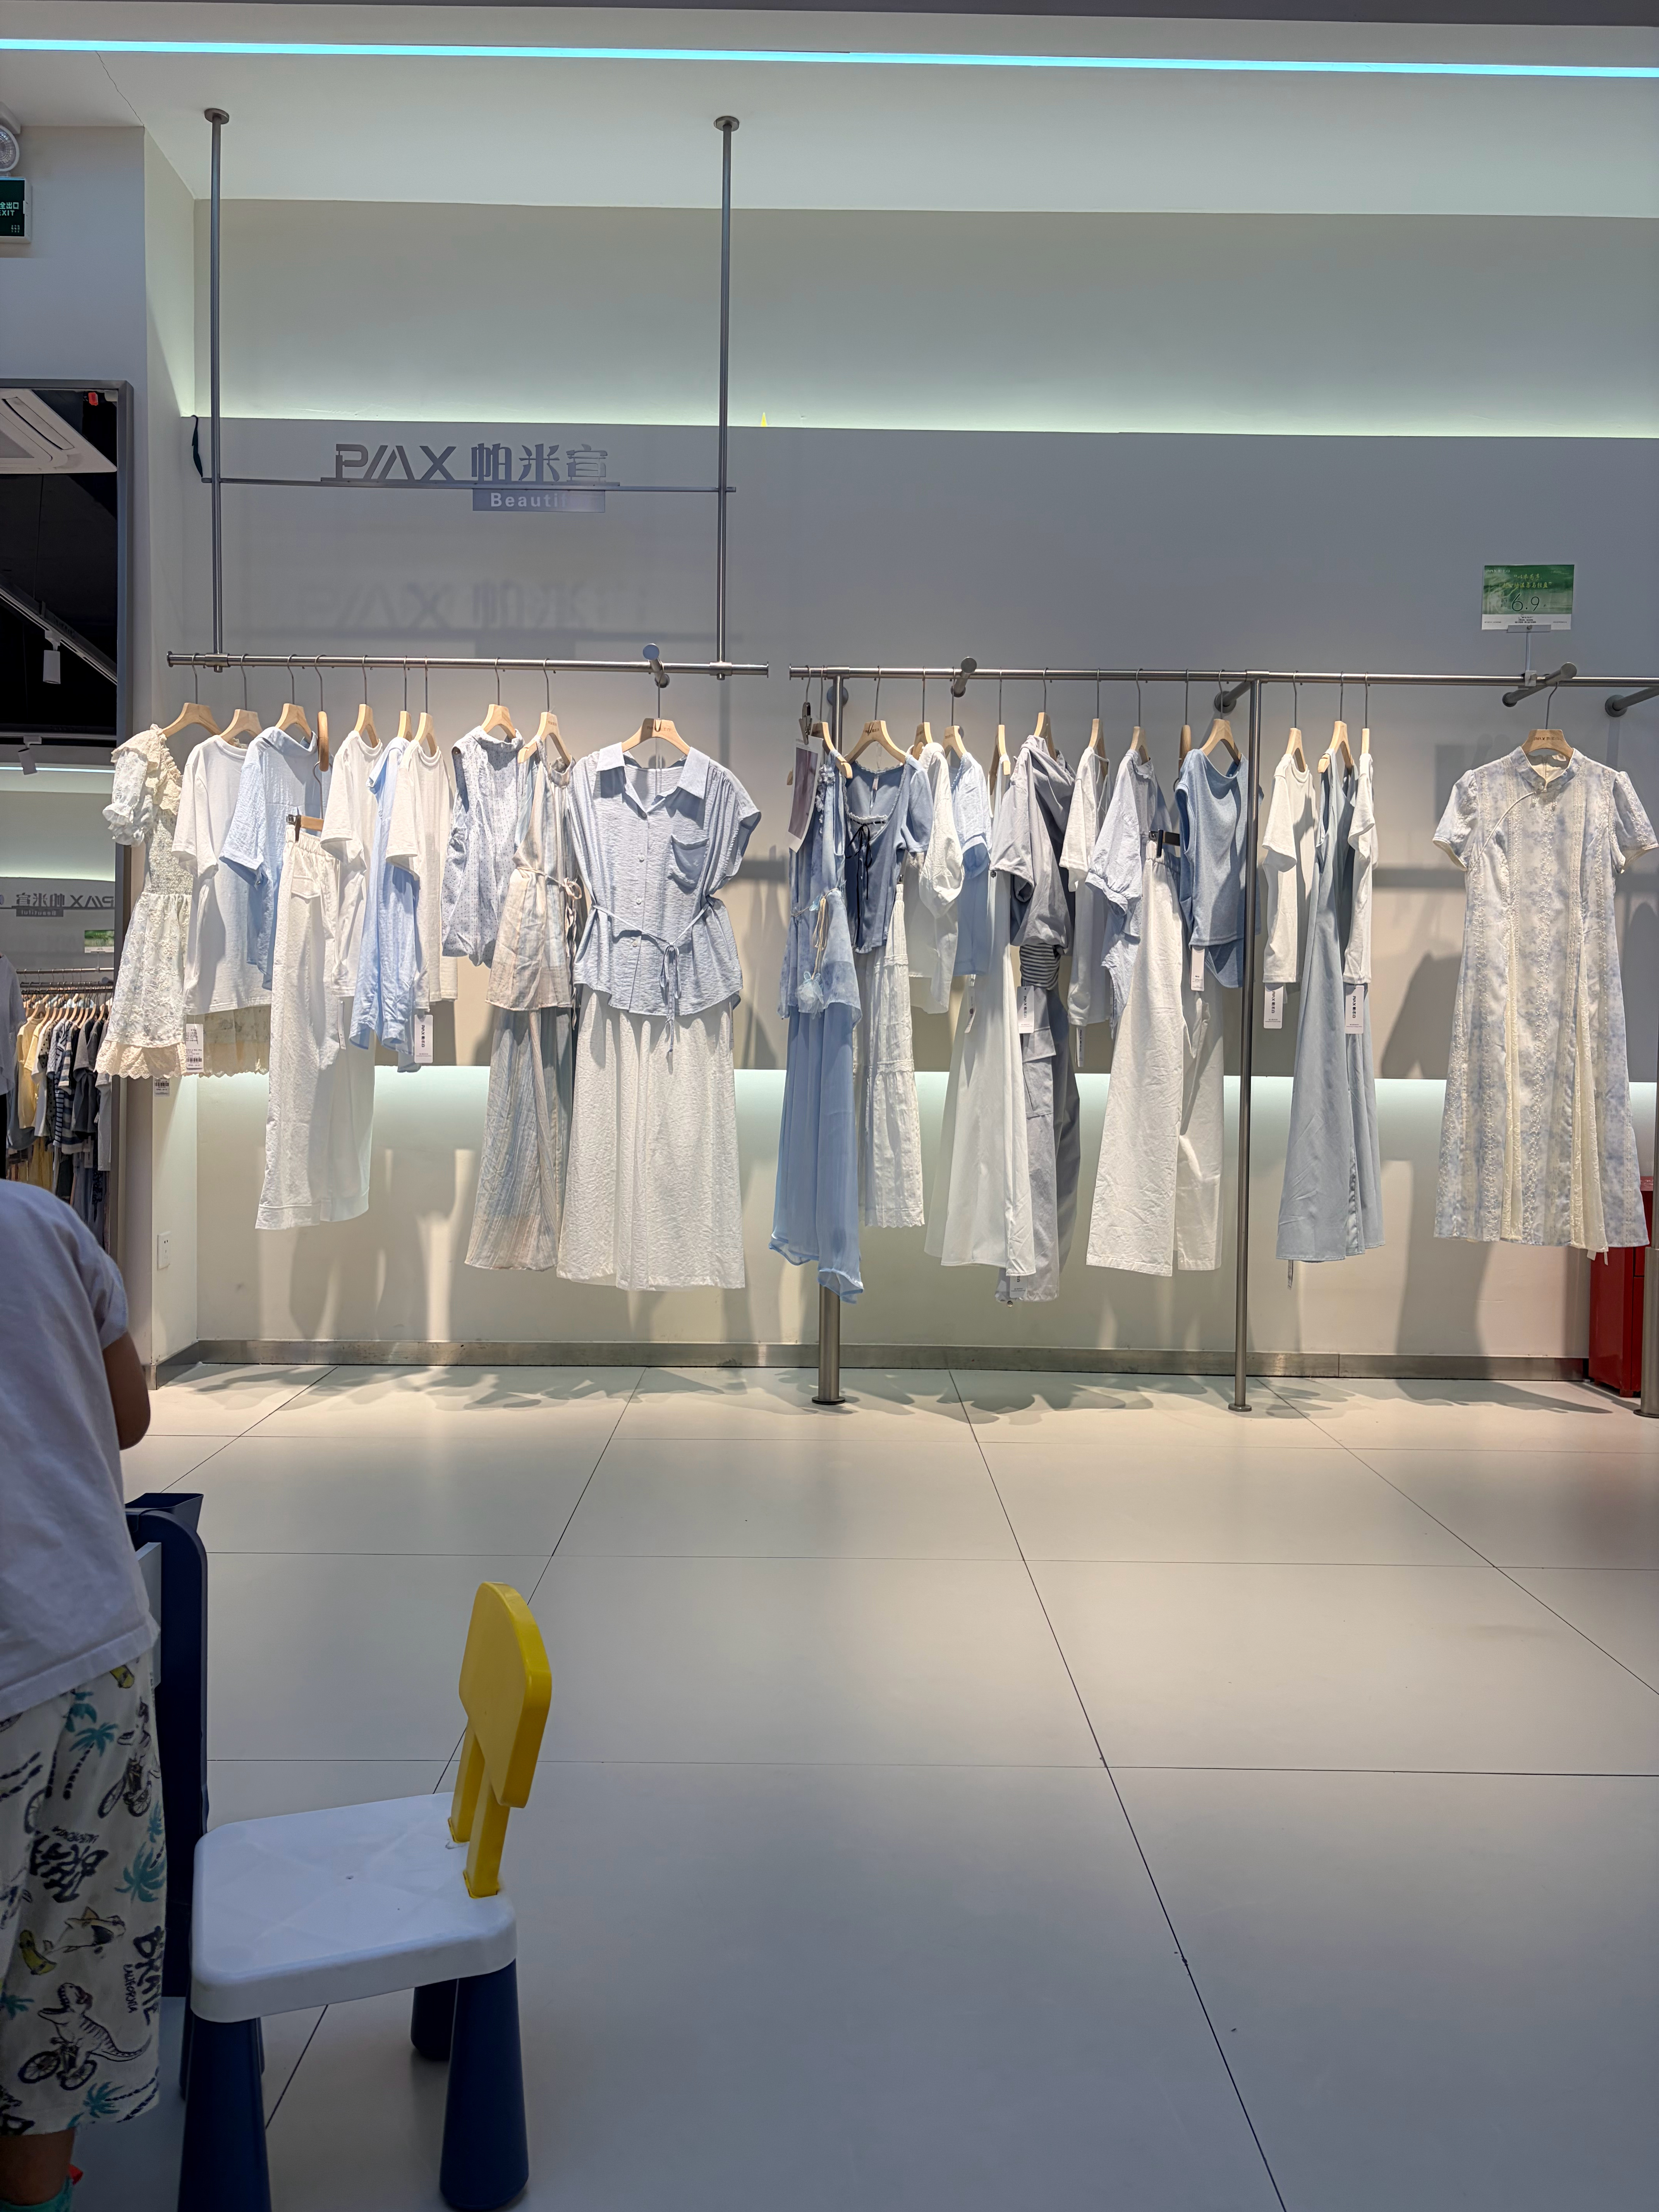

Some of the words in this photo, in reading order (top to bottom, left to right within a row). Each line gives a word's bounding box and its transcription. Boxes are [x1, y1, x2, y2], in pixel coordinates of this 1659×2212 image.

[491, 493, 567, 507] Beautif
[1511, 593, 1540, 611] 6.9
[123, 1964, 138, 2014] CALIFORNIA
